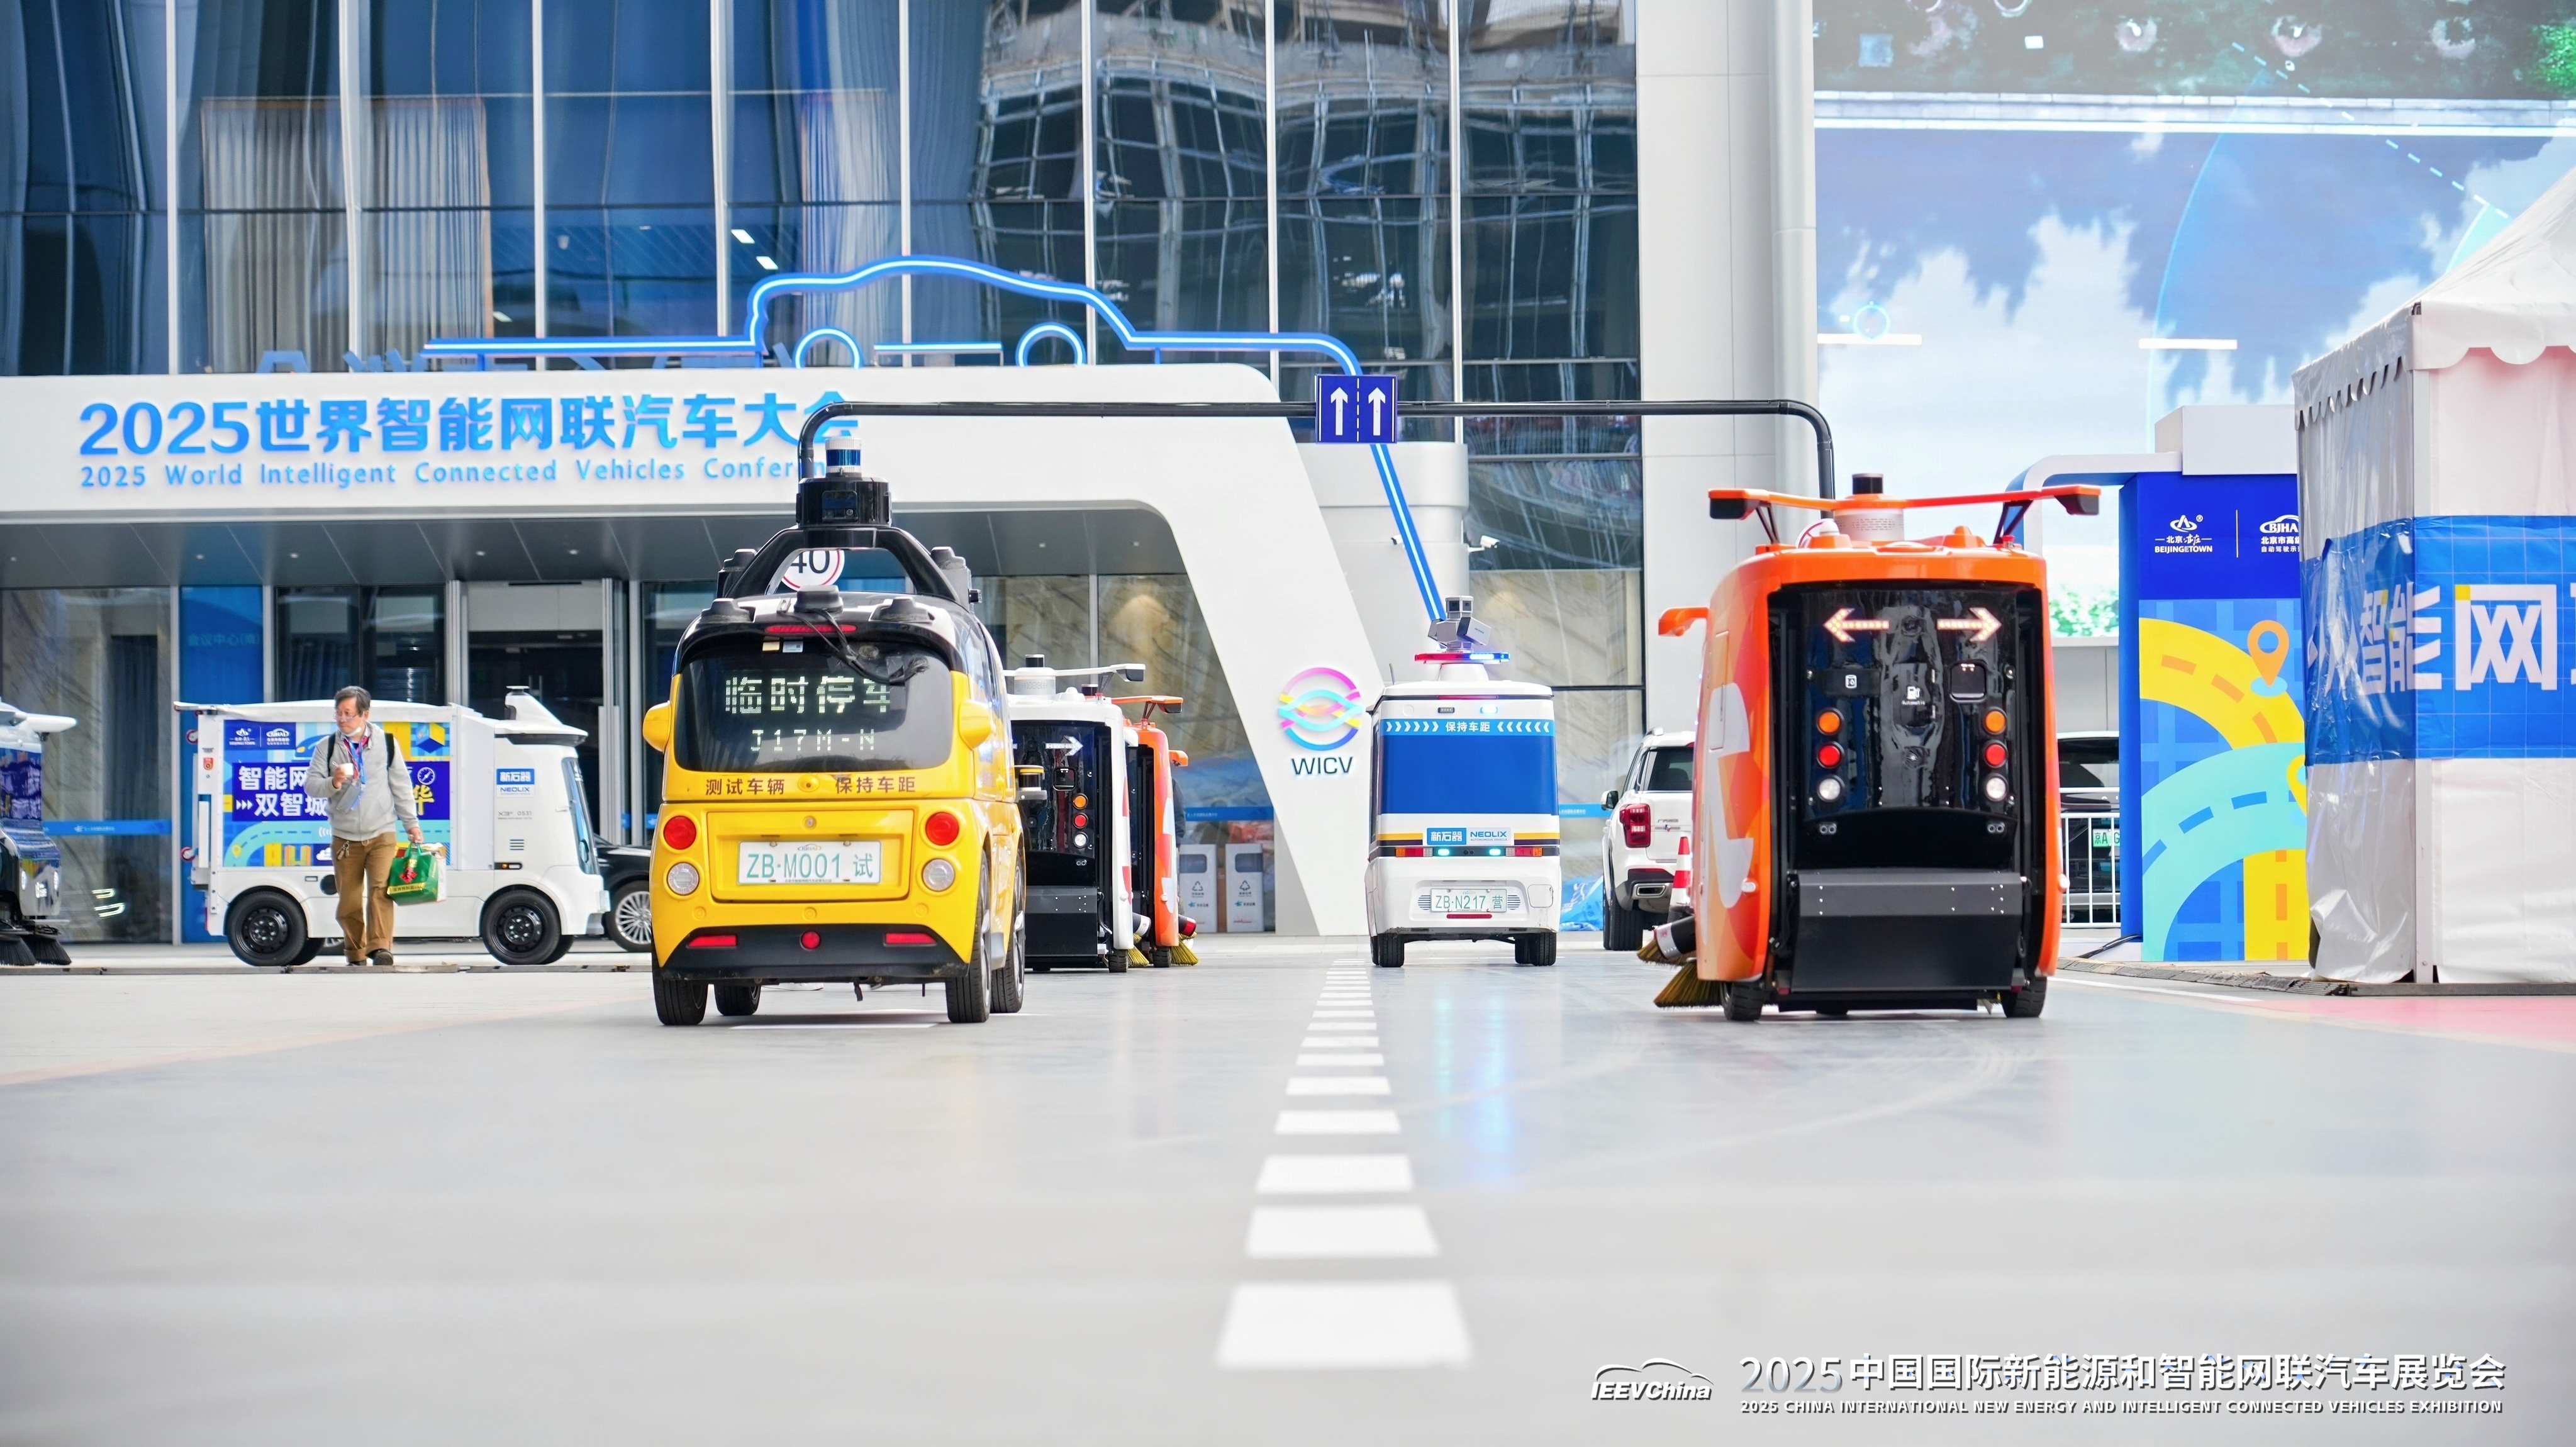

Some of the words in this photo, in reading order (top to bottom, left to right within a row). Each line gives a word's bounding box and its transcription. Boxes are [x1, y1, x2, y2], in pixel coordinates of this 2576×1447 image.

[81, 466, 146, 486] 2025
[165, 463, 242, 484] World
[261, 462, 396, 488] Intelligent
[415, 459, 557, 483] Connected
[576, 457, 686, 480] Vehicles
[704, 455, 826, 478] Confern
[2269, 523, 2299, 534] BJHA
[2155, 545, 2212, 554] BEIJINGETOWN
[2359, 581, 2576, 695] 智能网
[725, 676, 891, 714] 临时停车
[1446, 721, 1490, 732] 保持车距
[1291, 756, 1353, 775] WICV
[705, 778, 785, 796] 测试车辆
[834, 776, 917, 794] 保持车距
[1430, 831, 1463, 842] 新石器
[853, 852, 874, 878] 试
[1492, 895, 1503, 909] 营
